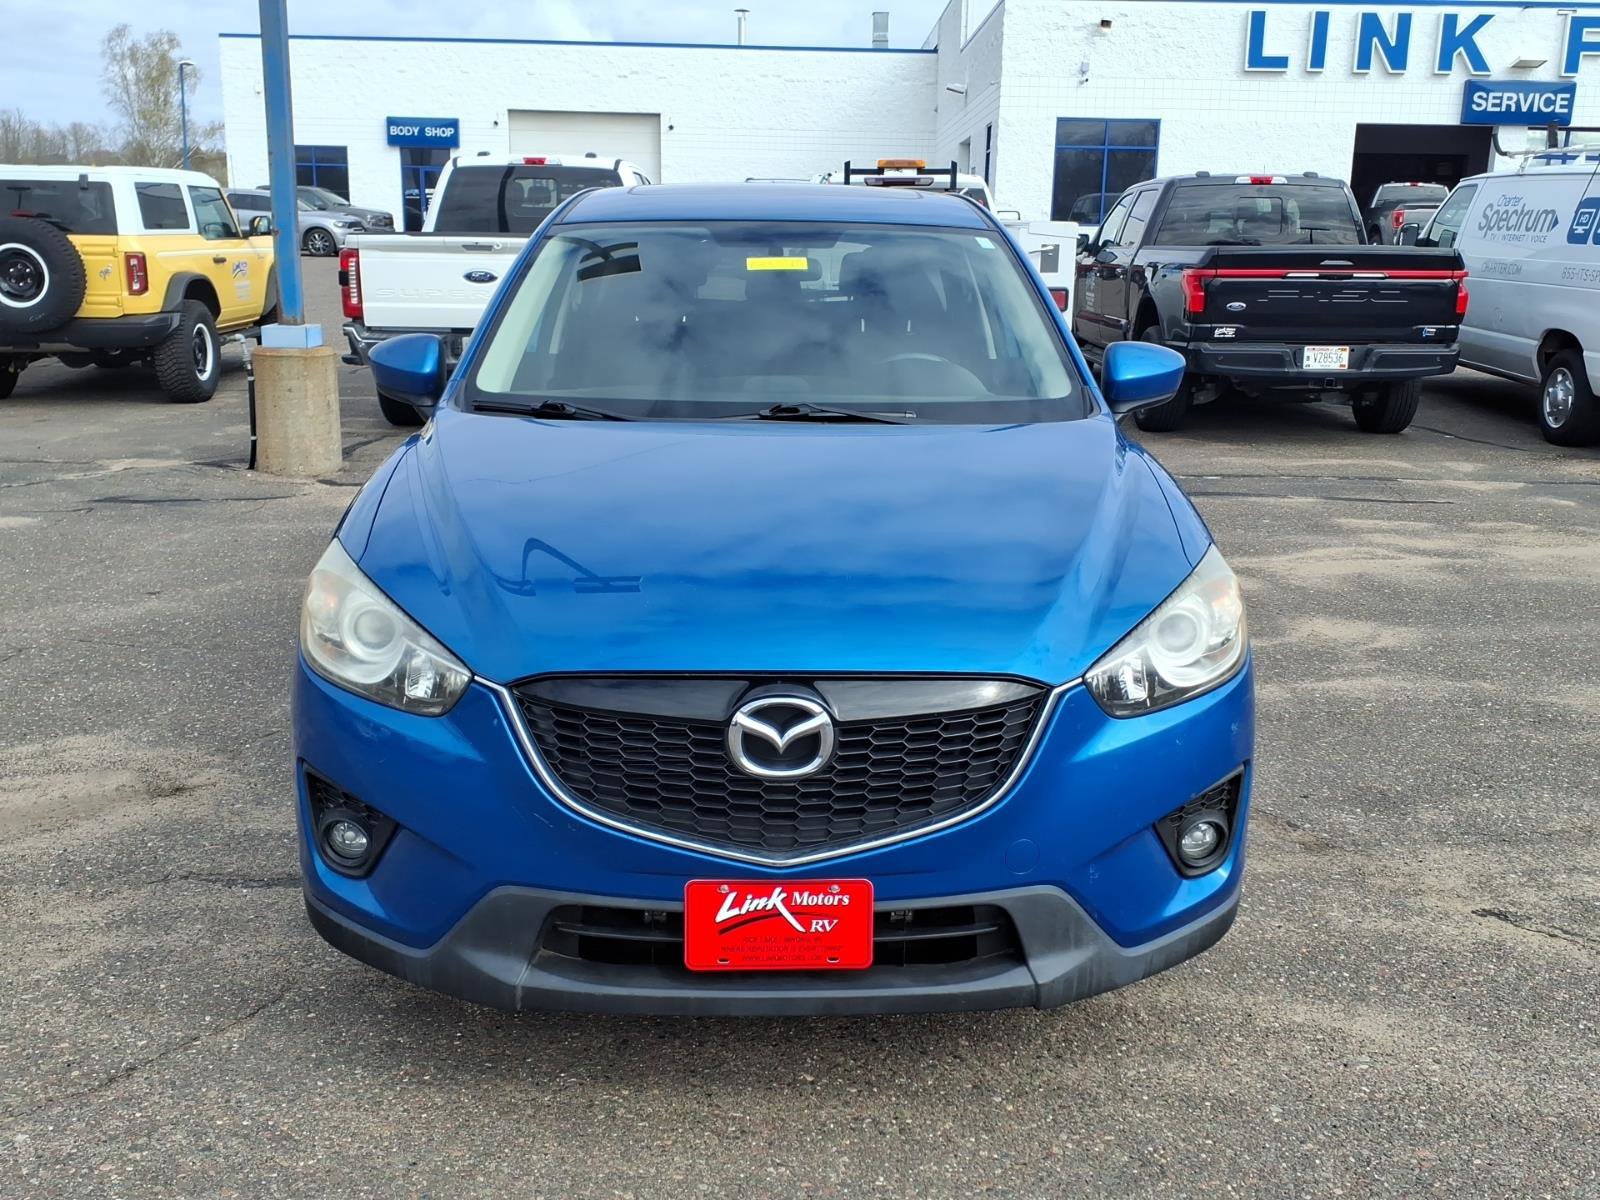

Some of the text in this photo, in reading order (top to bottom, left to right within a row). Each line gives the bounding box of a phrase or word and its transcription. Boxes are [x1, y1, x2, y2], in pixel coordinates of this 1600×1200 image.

[1244, 9, 1495, 77] LINK
[1471, 91, 1570, 114] SERVICE
[389, 126, 455, 137] BODY SHOP
[1496, 194, 1524, 207] Charter
[1478, 203, 1556, 239] Spectrum
[1313, 352, 1344, 364] VZ8536
[715, 887, 850, 932] Link Motors
[810, 919, 838, 932] RV
